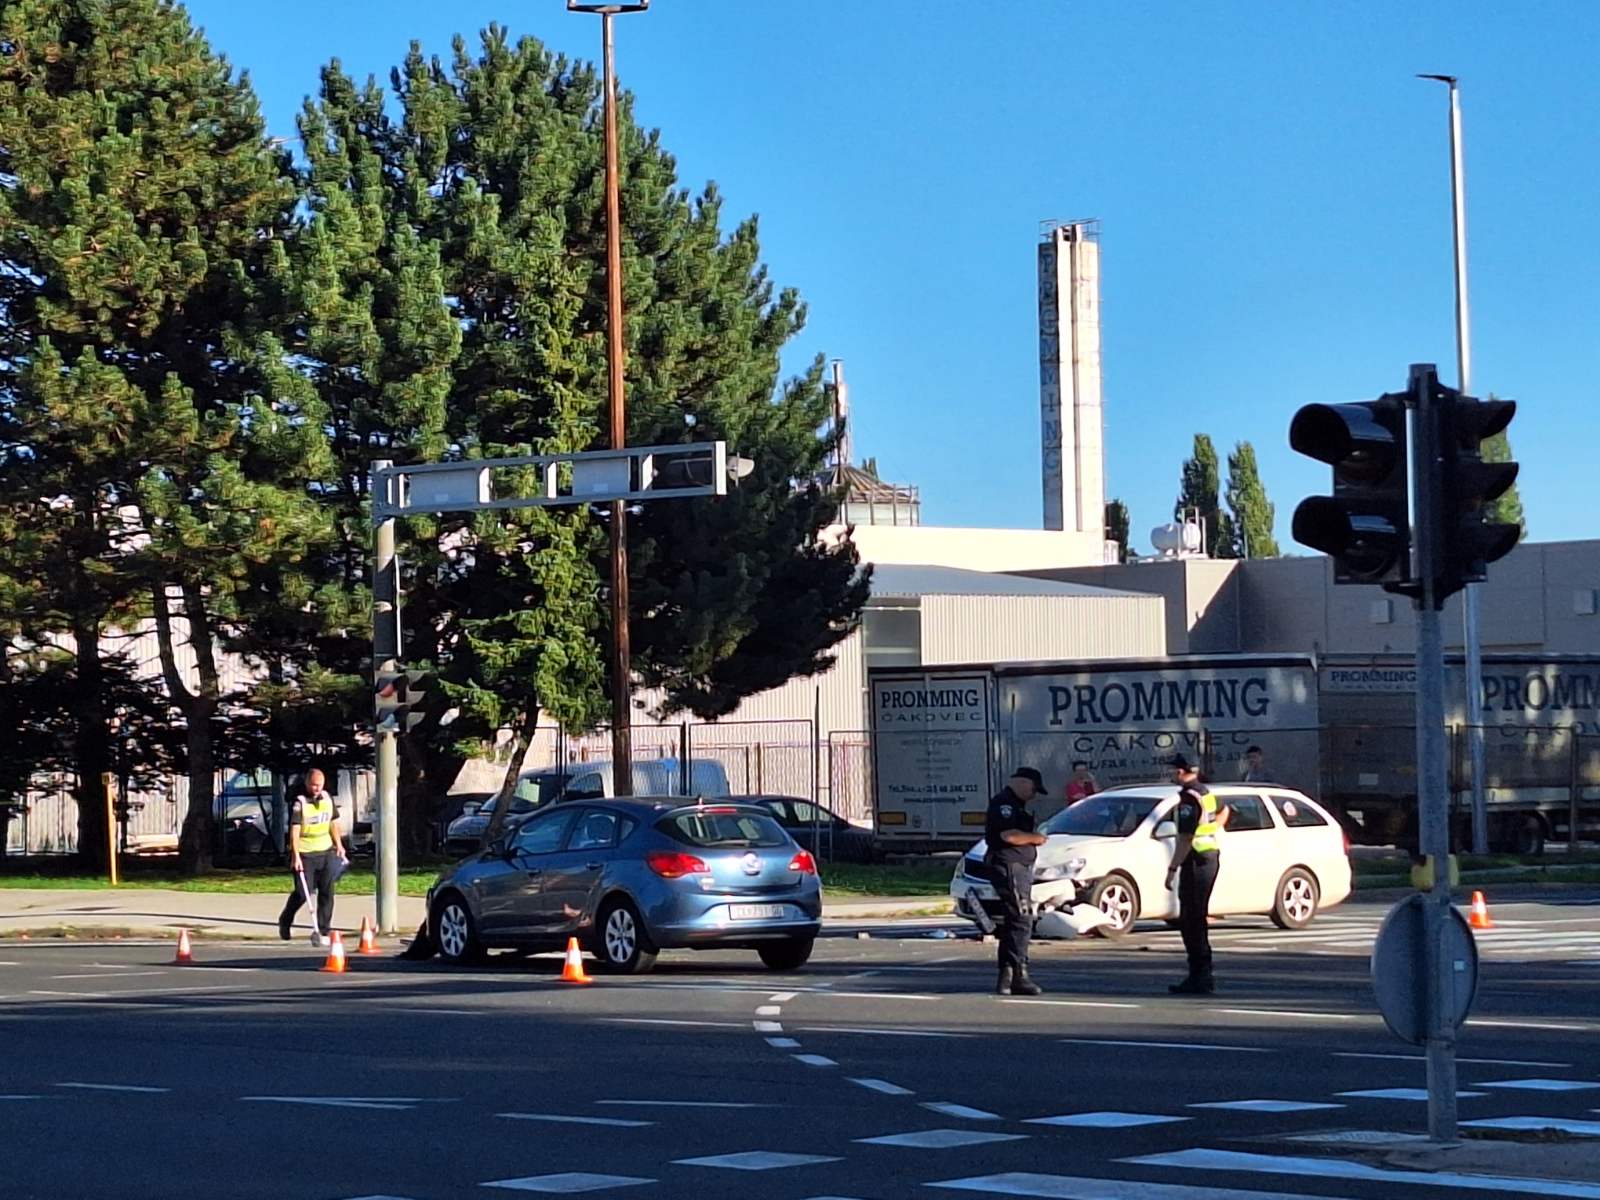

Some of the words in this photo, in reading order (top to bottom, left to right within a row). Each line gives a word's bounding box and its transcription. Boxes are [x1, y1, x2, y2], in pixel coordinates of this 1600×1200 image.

[1331, 671, 1416, 682] PROMMING
[881, 689, 979, 708] PROMMING
[1048, 678, 1270, 725] PROMMING
